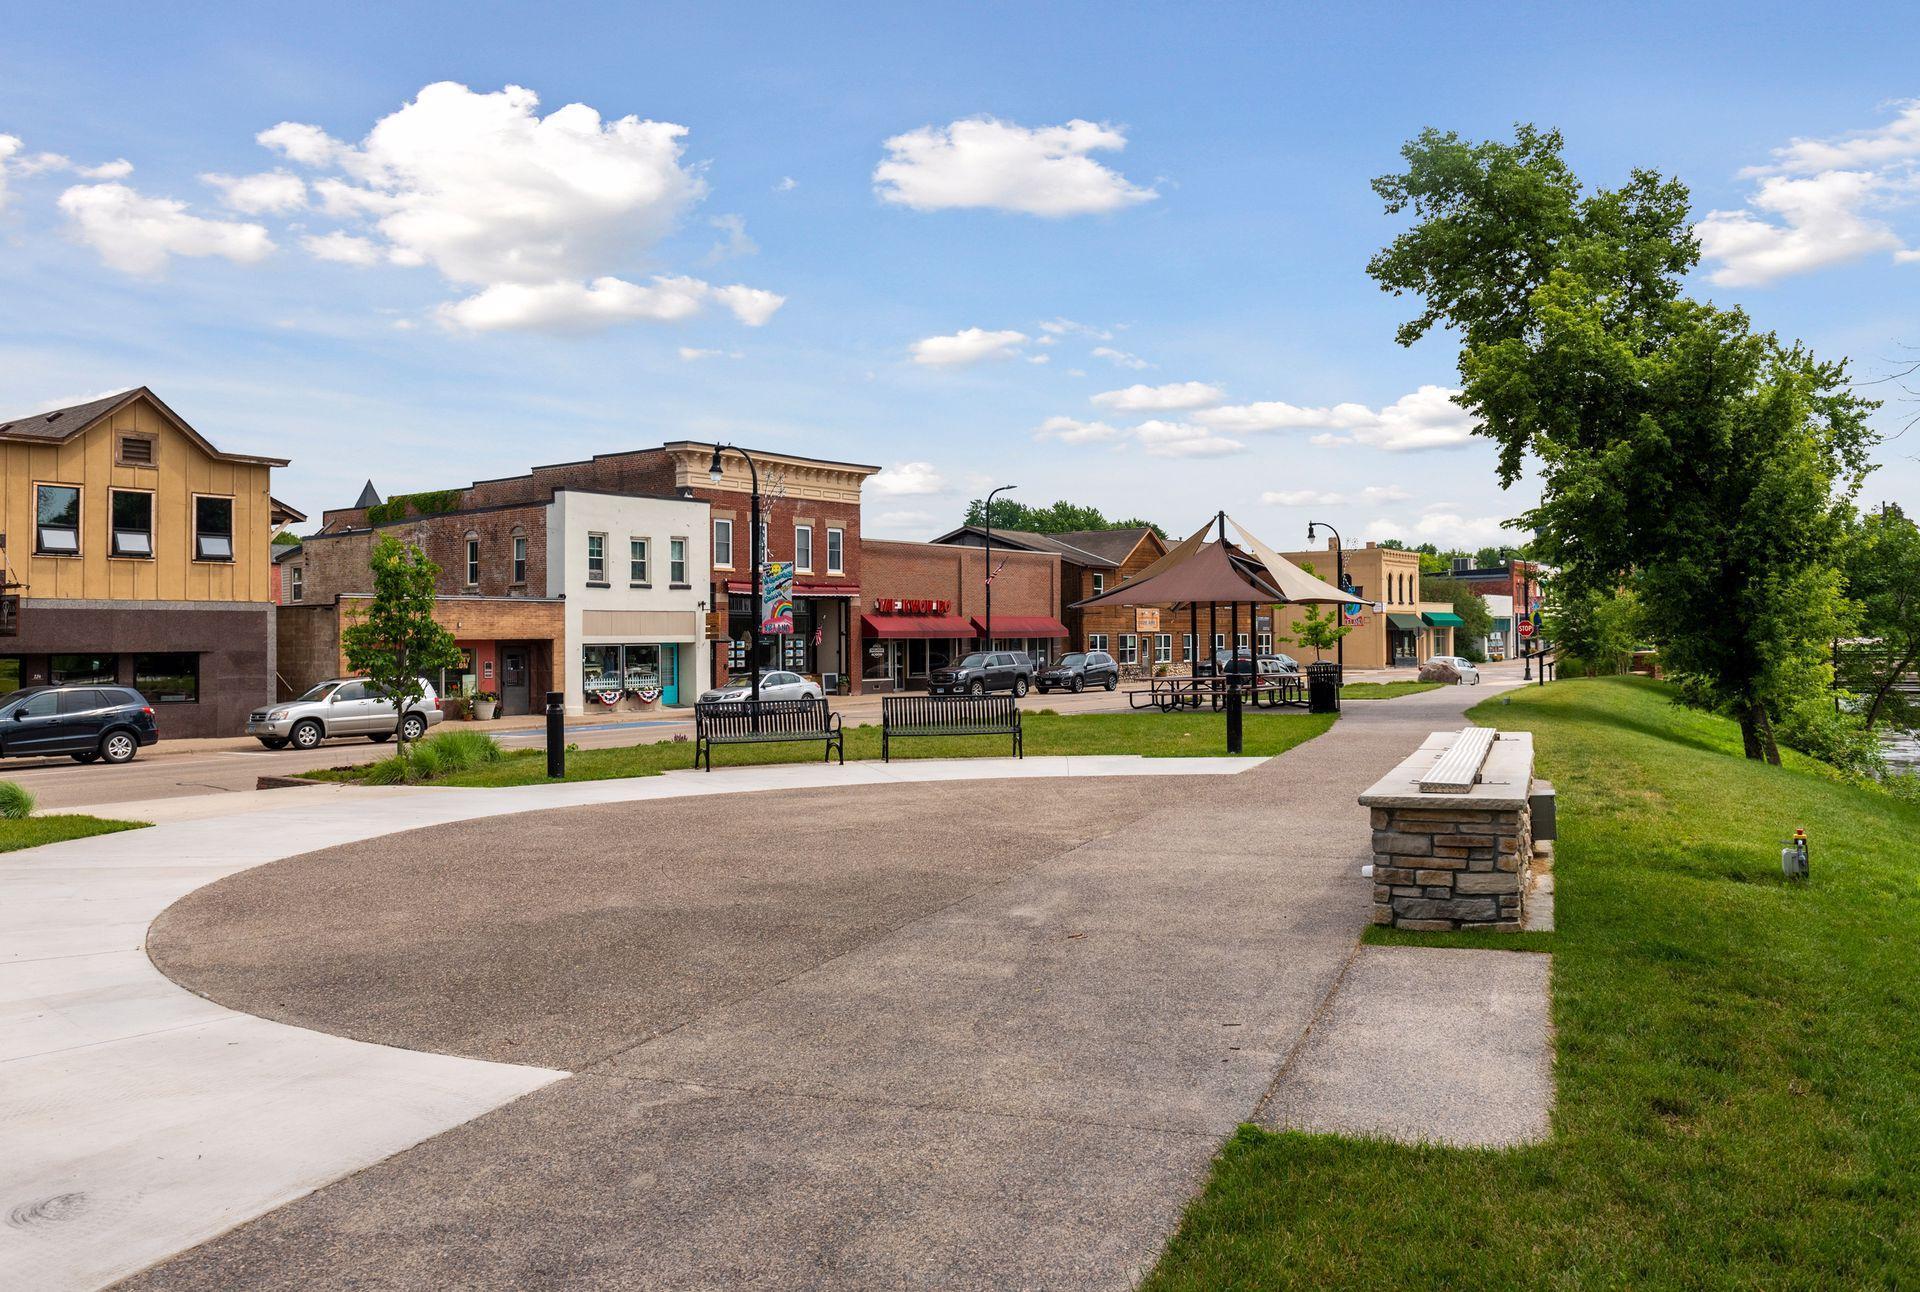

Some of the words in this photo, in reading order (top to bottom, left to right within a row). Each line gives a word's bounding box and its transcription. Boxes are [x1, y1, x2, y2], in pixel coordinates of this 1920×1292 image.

[879, 598, 898, 612] TAE
[902, 599, 933, 612] KWON
[937, 600, 951, 612] DO
